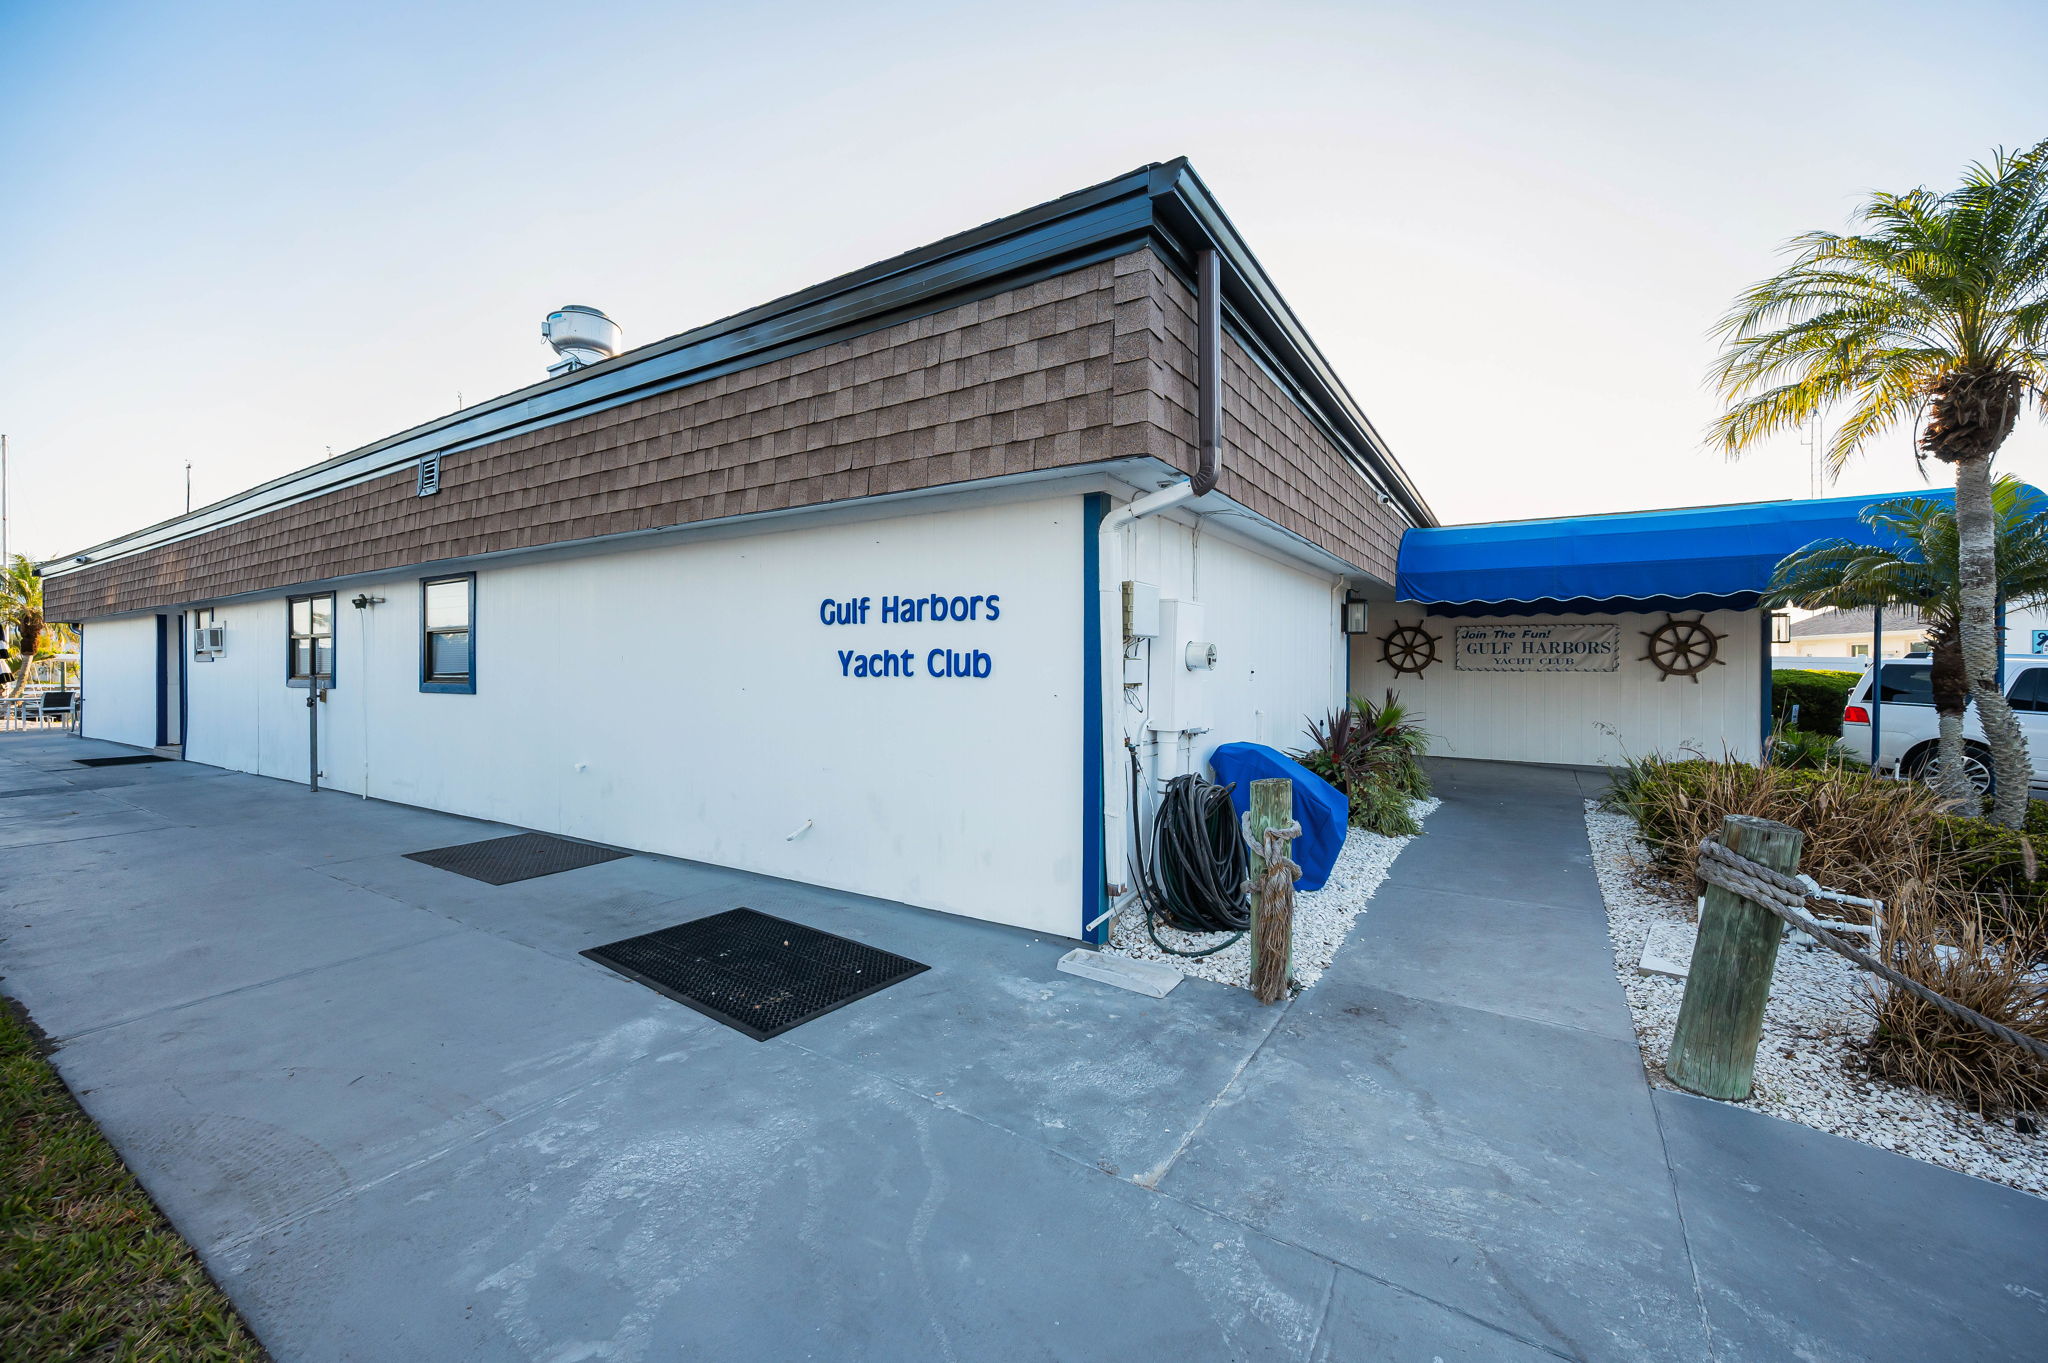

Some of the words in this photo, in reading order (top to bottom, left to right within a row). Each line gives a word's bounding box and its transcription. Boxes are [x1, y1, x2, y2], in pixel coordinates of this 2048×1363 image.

[820, 597, 870, 625] Gulf
[881, 594, 1000, 624] Harbors
[1461, 631, 1487, 639] Join
[1493, 630, 1516, 638] The
[1522, 630, 1551, 638] Fun!
[1466, 642, 1513, 655] GULF
[1522, 641, 1611, 654] HARBORS
[838, 649, 914, 677] Yacht
[927, 648, 992, 678] Club
[1494, 657, 1534, 665] YACHT
[1539, 657, 1574, 665] CLUB
